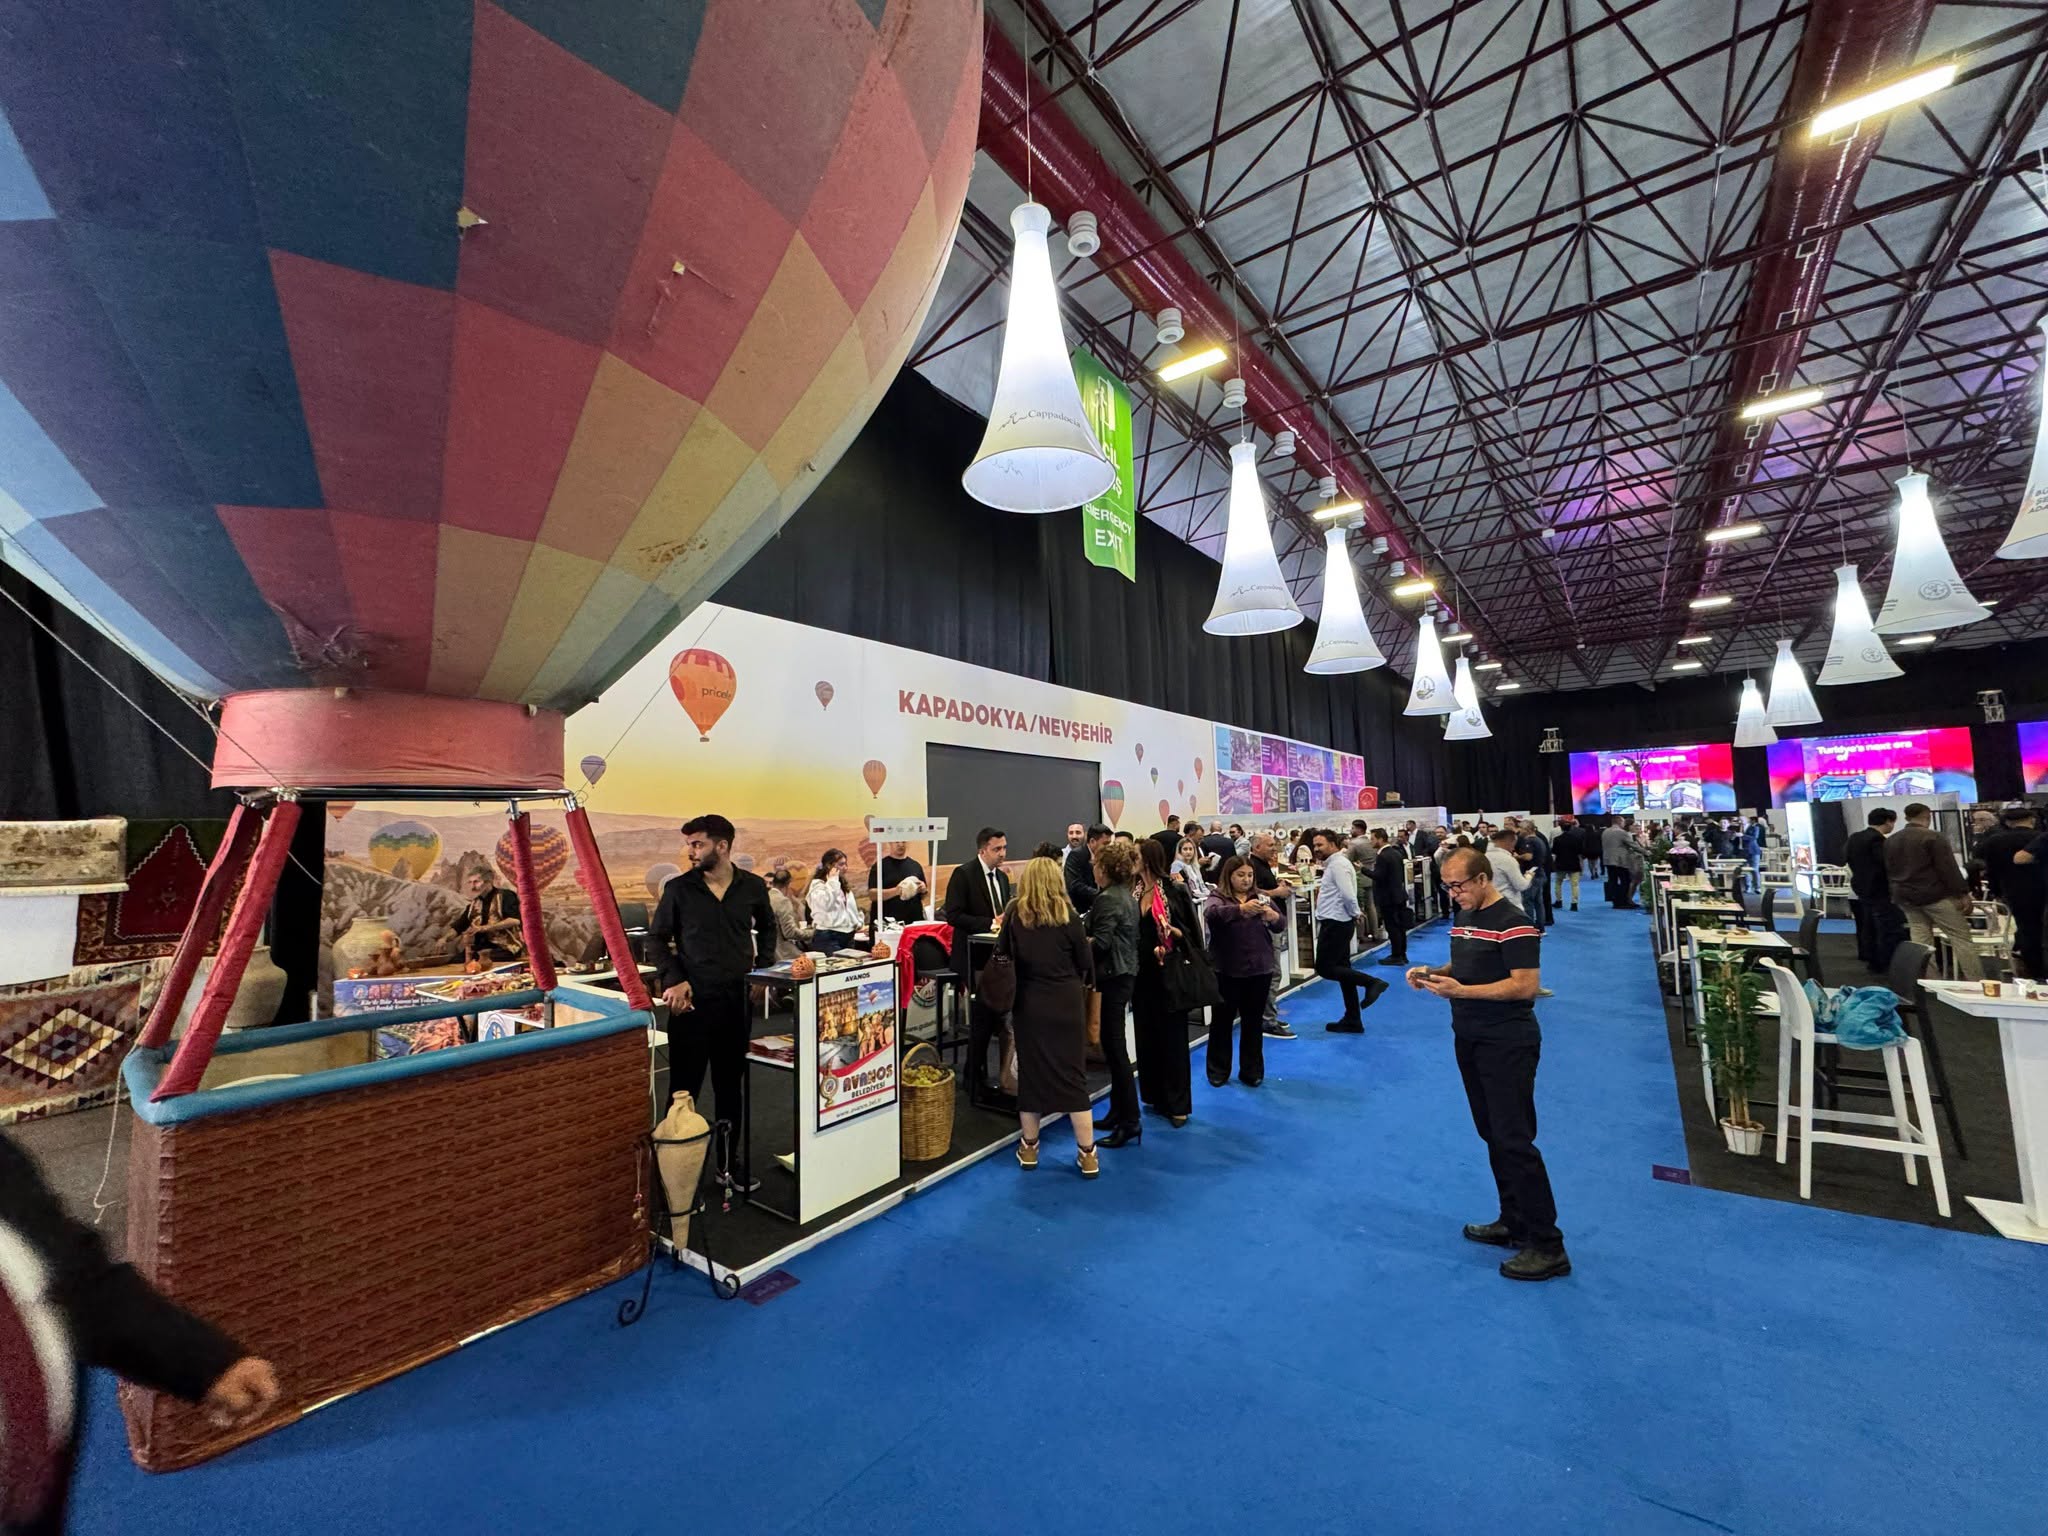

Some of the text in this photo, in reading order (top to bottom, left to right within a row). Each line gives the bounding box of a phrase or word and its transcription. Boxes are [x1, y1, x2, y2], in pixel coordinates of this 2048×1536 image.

[1028, 409, 1081, 428] Cappadocia
[1085, 503, 1131, 536] EMERGENCY
[1095, 527, 1123, 554] EXIT
[1865, 742, 1891, 751] next
[1893, 741, 1913, 749] era
[845, 972, 871, 982] AVANOS
[842, 1064, 893, 1092] AVANOS
[851, 1082, 886, 1098] BELEDİYESİ
